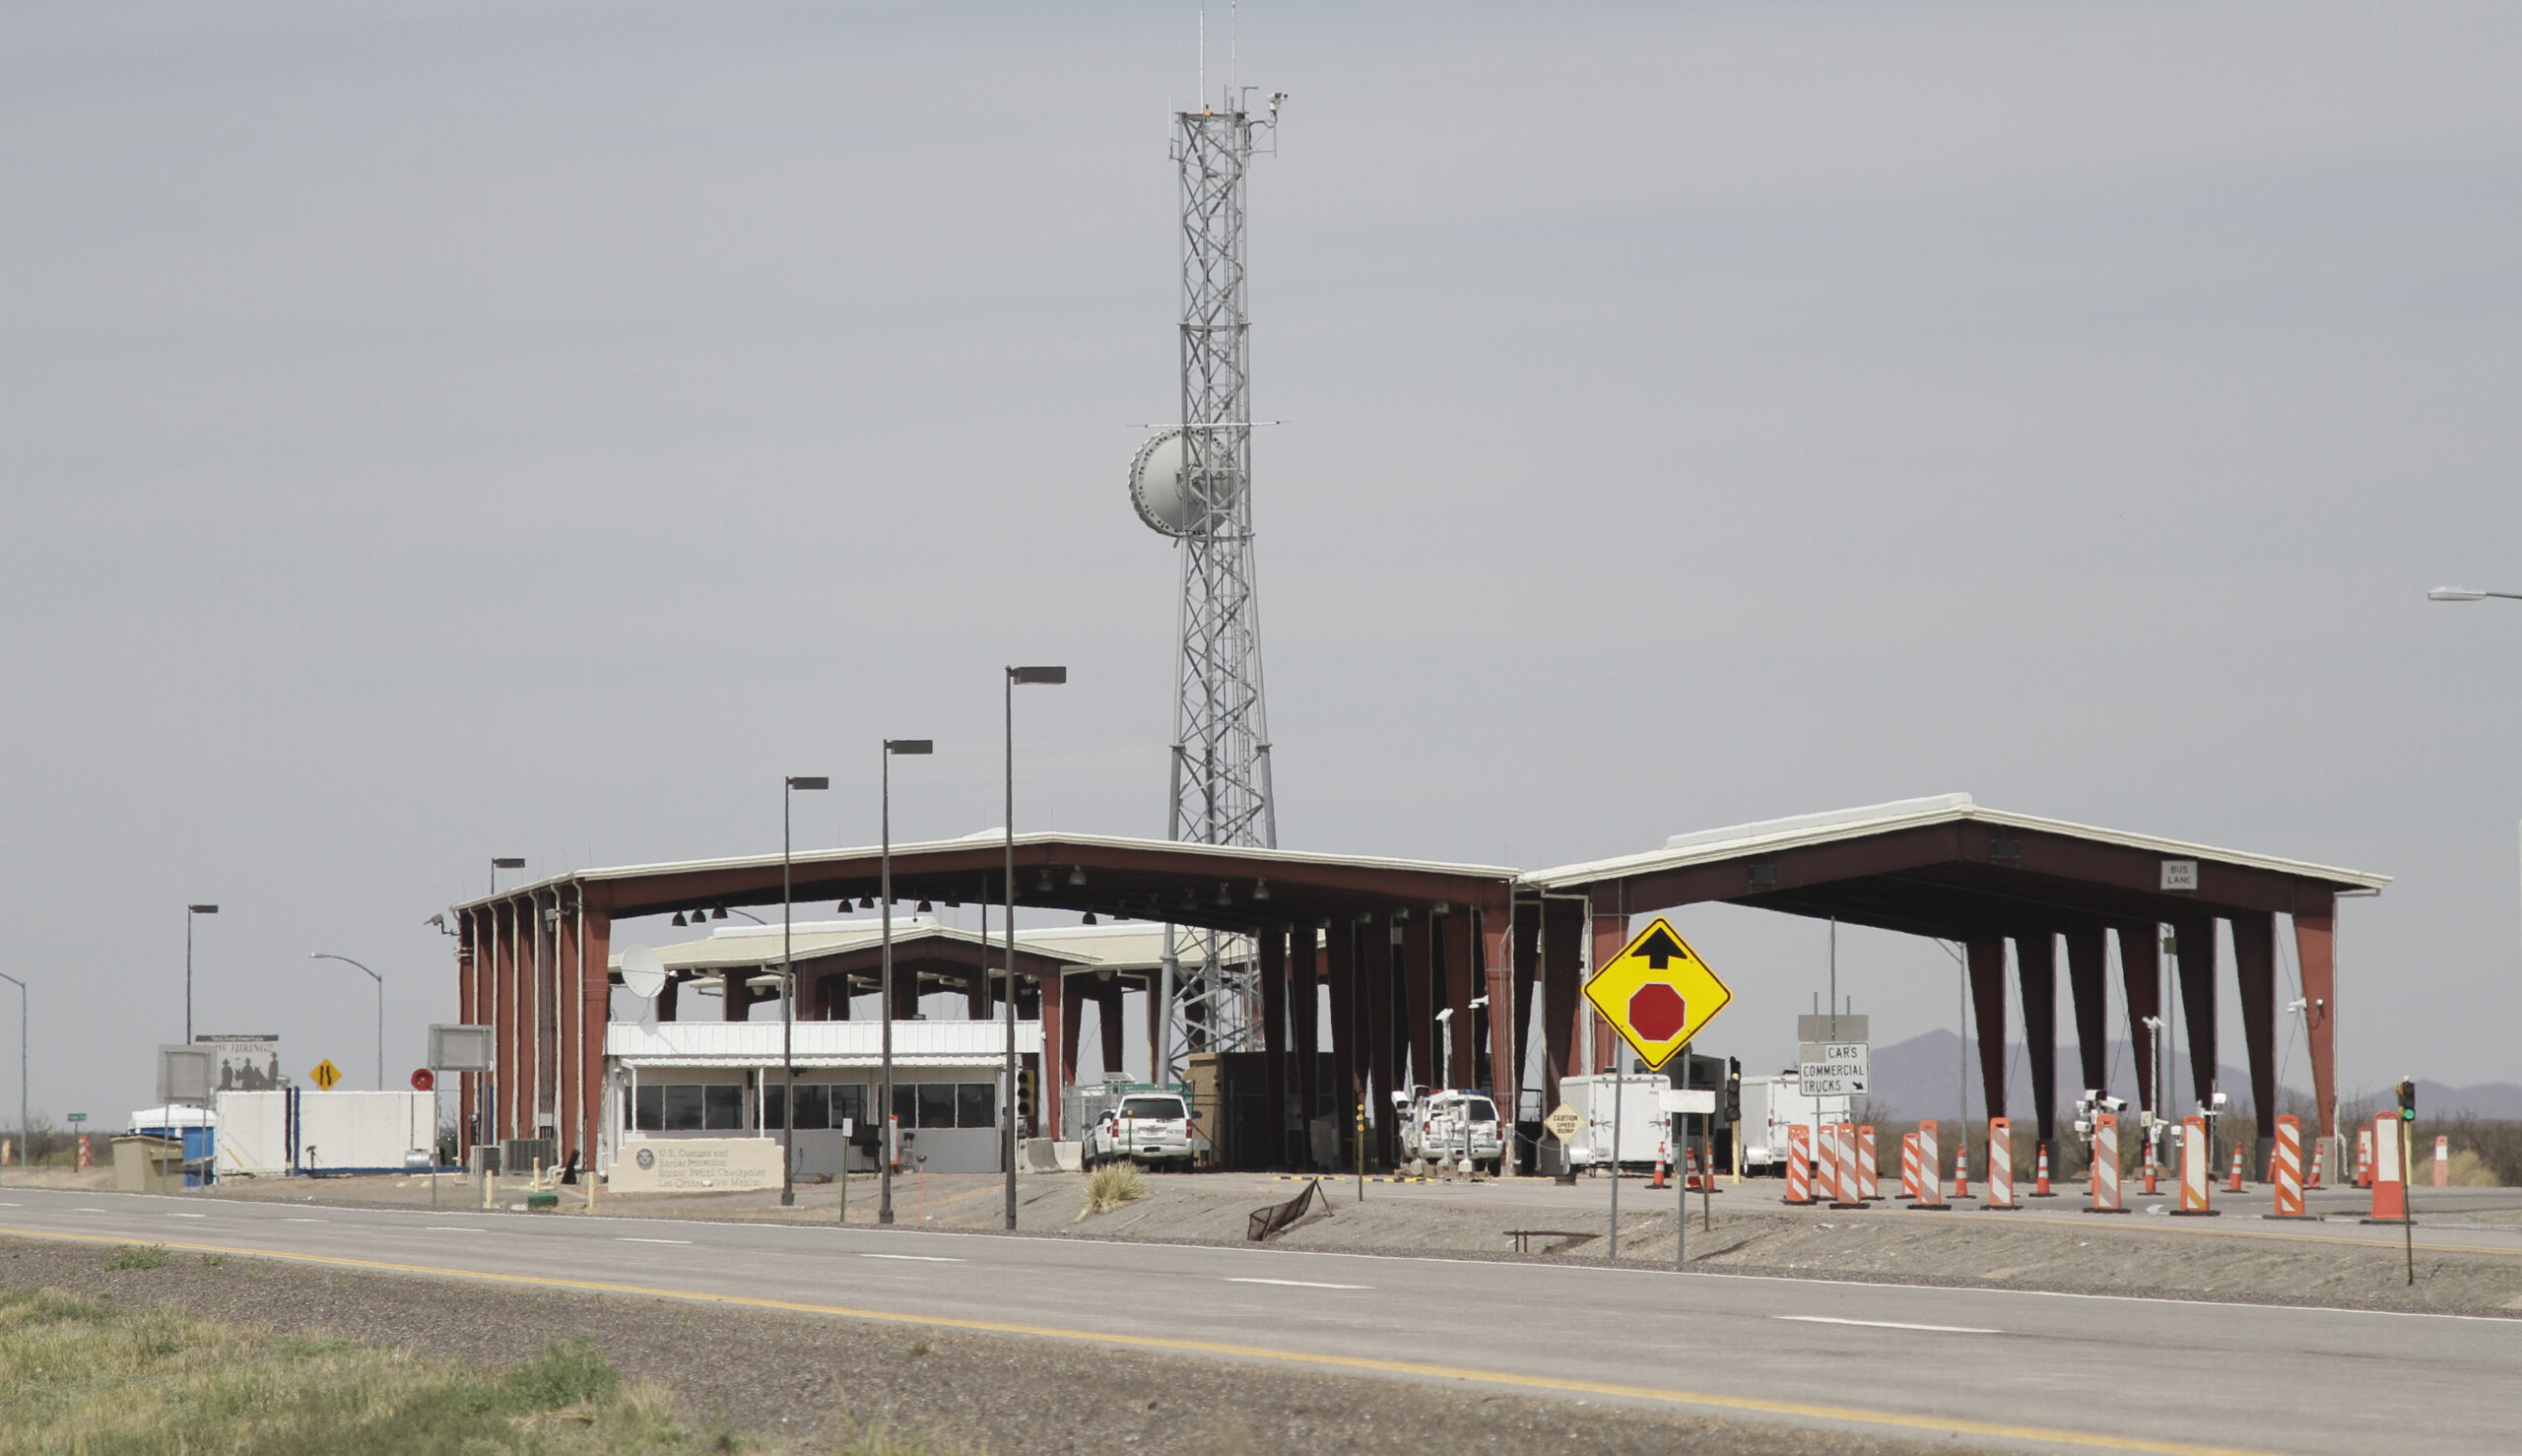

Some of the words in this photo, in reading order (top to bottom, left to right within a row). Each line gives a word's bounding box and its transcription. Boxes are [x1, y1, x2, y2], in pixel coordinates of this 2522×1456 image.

[2170, 865, 2188, 874] BUS
[2167, 876, 2192, 885] LANE
[1827, 1047, 1858, 1059] CARS
[1803, 1065, 1865, 1078] COMMERCIAL
[1804, 1080, 1841, 1092] TRUCKS
[658, 1149, 676, 1158] U.S.
[678, 1149, 711, 1158] Customs
[713, 1149, 729, 1158] and
[659, 1158, 687, 1167] Border
[688, 1158, 727, 1167] Protection
[658, 1168, 686, 1177] Border
[690, 1168, 715, 1177] Patrol
[717, 1168, 765, 1178] Checkpoint
